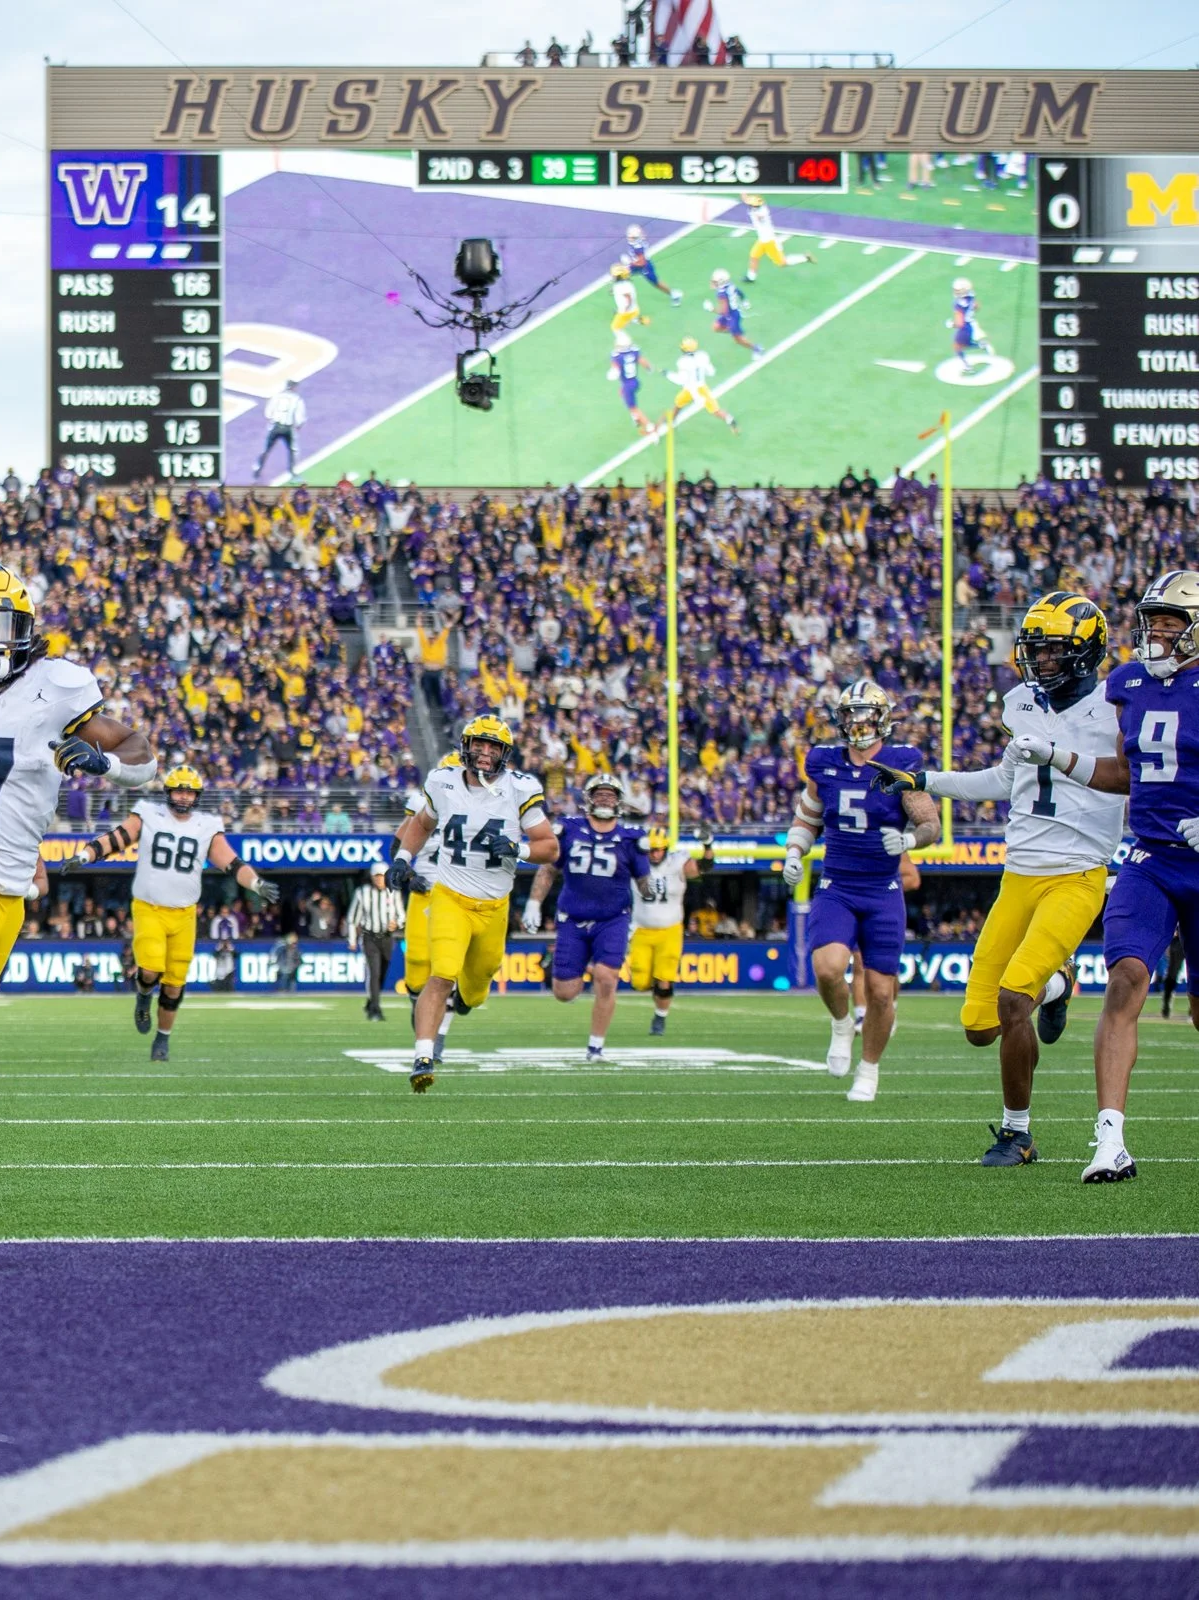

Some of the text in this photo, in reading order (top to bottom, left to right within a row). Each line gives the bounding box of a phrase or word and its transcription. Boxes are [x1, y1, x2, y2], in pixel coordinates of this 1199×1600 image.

[155, 74, 1102, 143] HUSKY STADIUM
[428, 157, 567, 181] 2ND & 3 39
[621, 156, 639, 182] 2
[681, 156, 760, 183] 5:26
[798, 159, 838, 181] 40
[58, 163, 148, 226] W
[1126, 172, 1199, 227] M
[155, 194, 216, 228] 14
[1048, 193, 1080, 229] 0
[59, 272, 211, 297] PASS 166
[1054, 275, 1199, 299] 20 PASS
[59, 310, 211, 333] RUSH 50
[1054, 313, 1199, 336] 63 RUSH
[58, 346, 211, 371] TOTAL 216
[1054, 350, 1199, 373] 83 TOTAL
[58, 382, 208, 407] TURNOVERS 0
[1058, 386, 1199, 409] 0 TURNOVERS
[59, 419, 200, 445] PEN/YDS 1/5
[1054, 423, 1199, 447] 1/5 PEN/YDS
[159, 453, 214, 478] 11:43
[1138, 711, 1179, 782] 9
[839, 789, 868, 833] 5
[152, 832, 198, 873] 68
[242, 838, 383, 862] novavax
[444, 815, 504, 869] 44
[569, 840, 617, 877] 55
[1130, 849, 1151, 863] W
